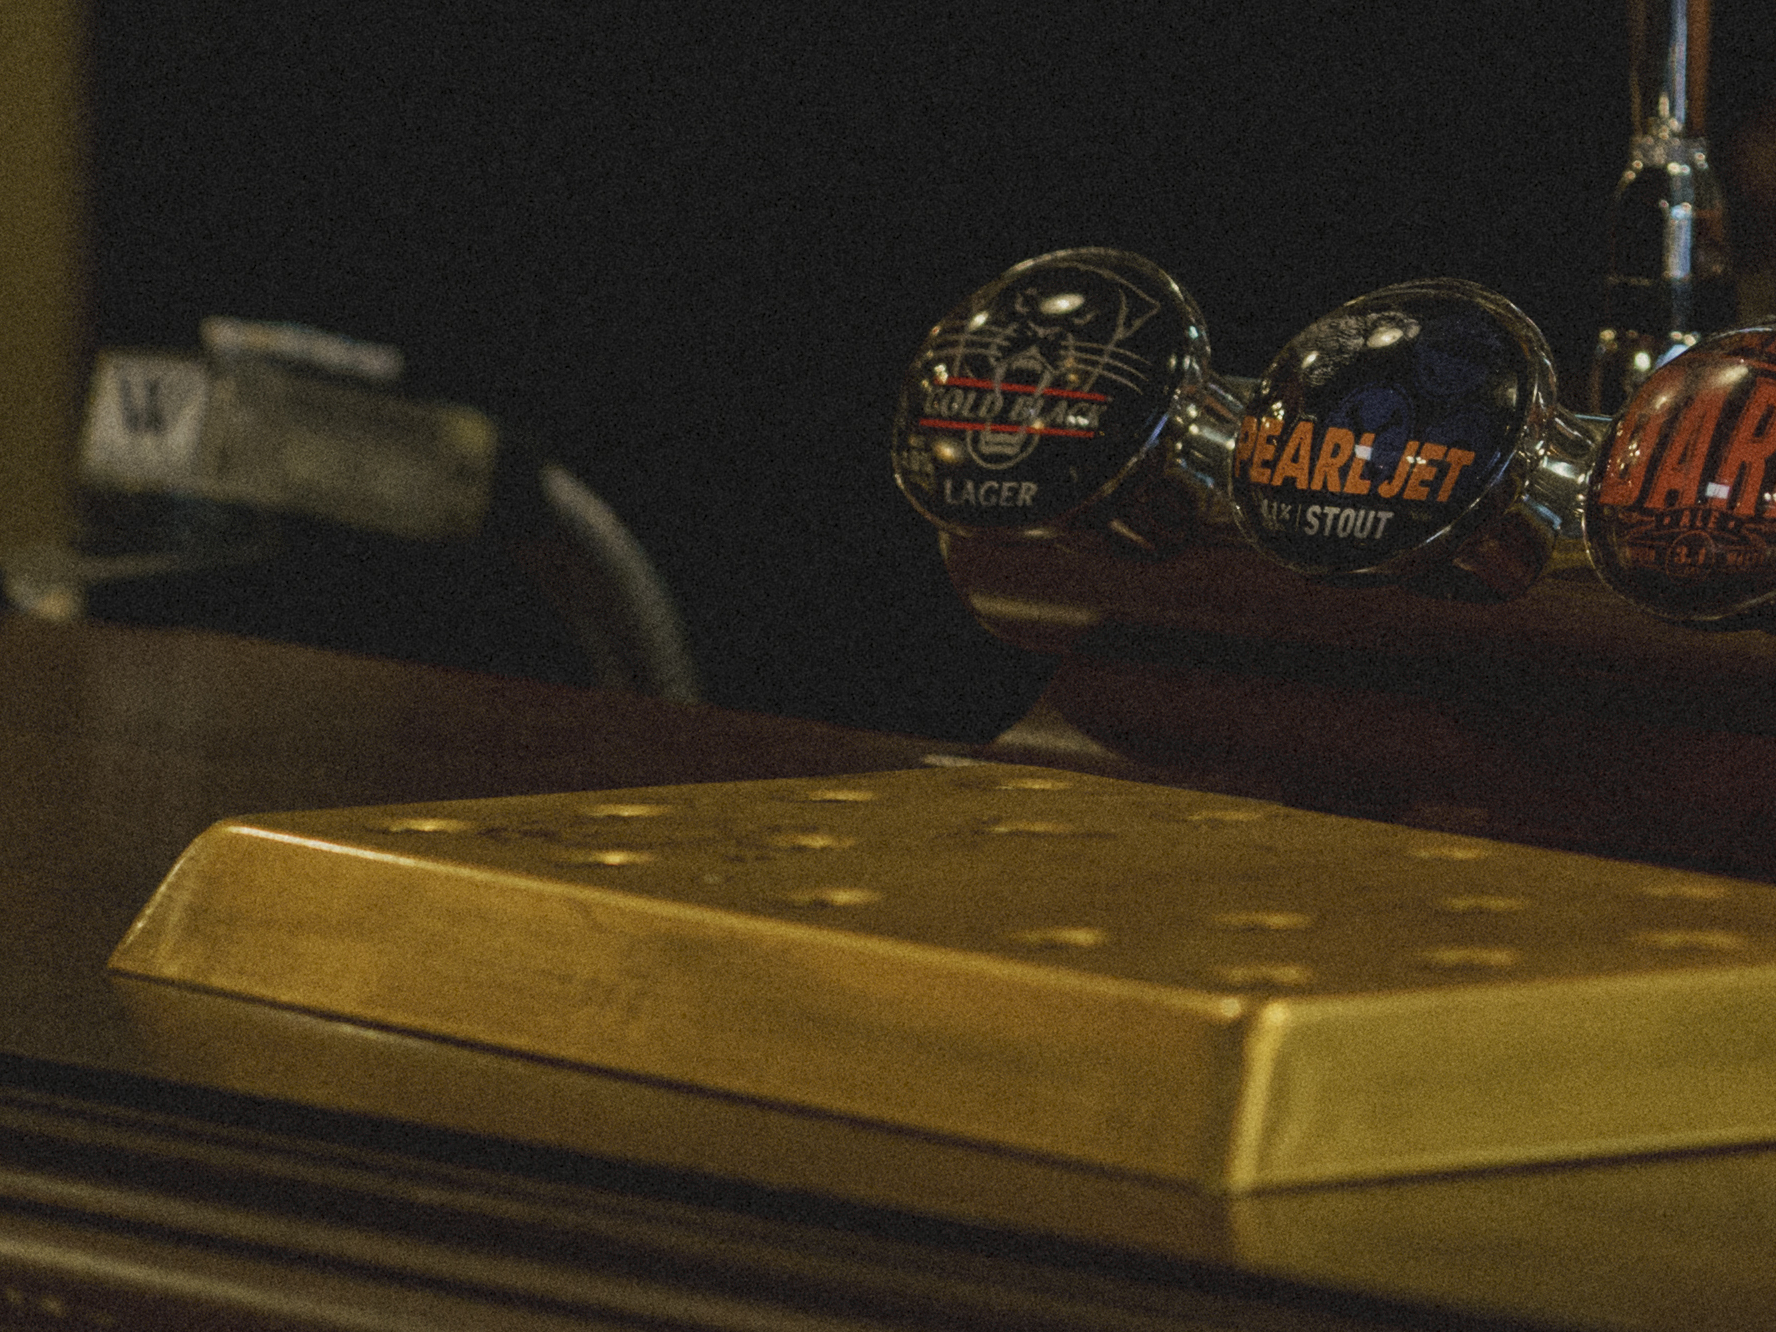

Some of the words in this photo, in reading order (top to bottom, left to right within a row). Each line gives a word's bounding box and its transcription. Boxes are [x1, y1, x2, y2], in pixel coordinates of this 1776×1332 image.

[1234, 415, 1376, 495] PEARL
[1378, 440, 1476, 503] JET
[943, 479, 1038, 507] LAGER
[1304, 504, 1395, 539] STOUT
